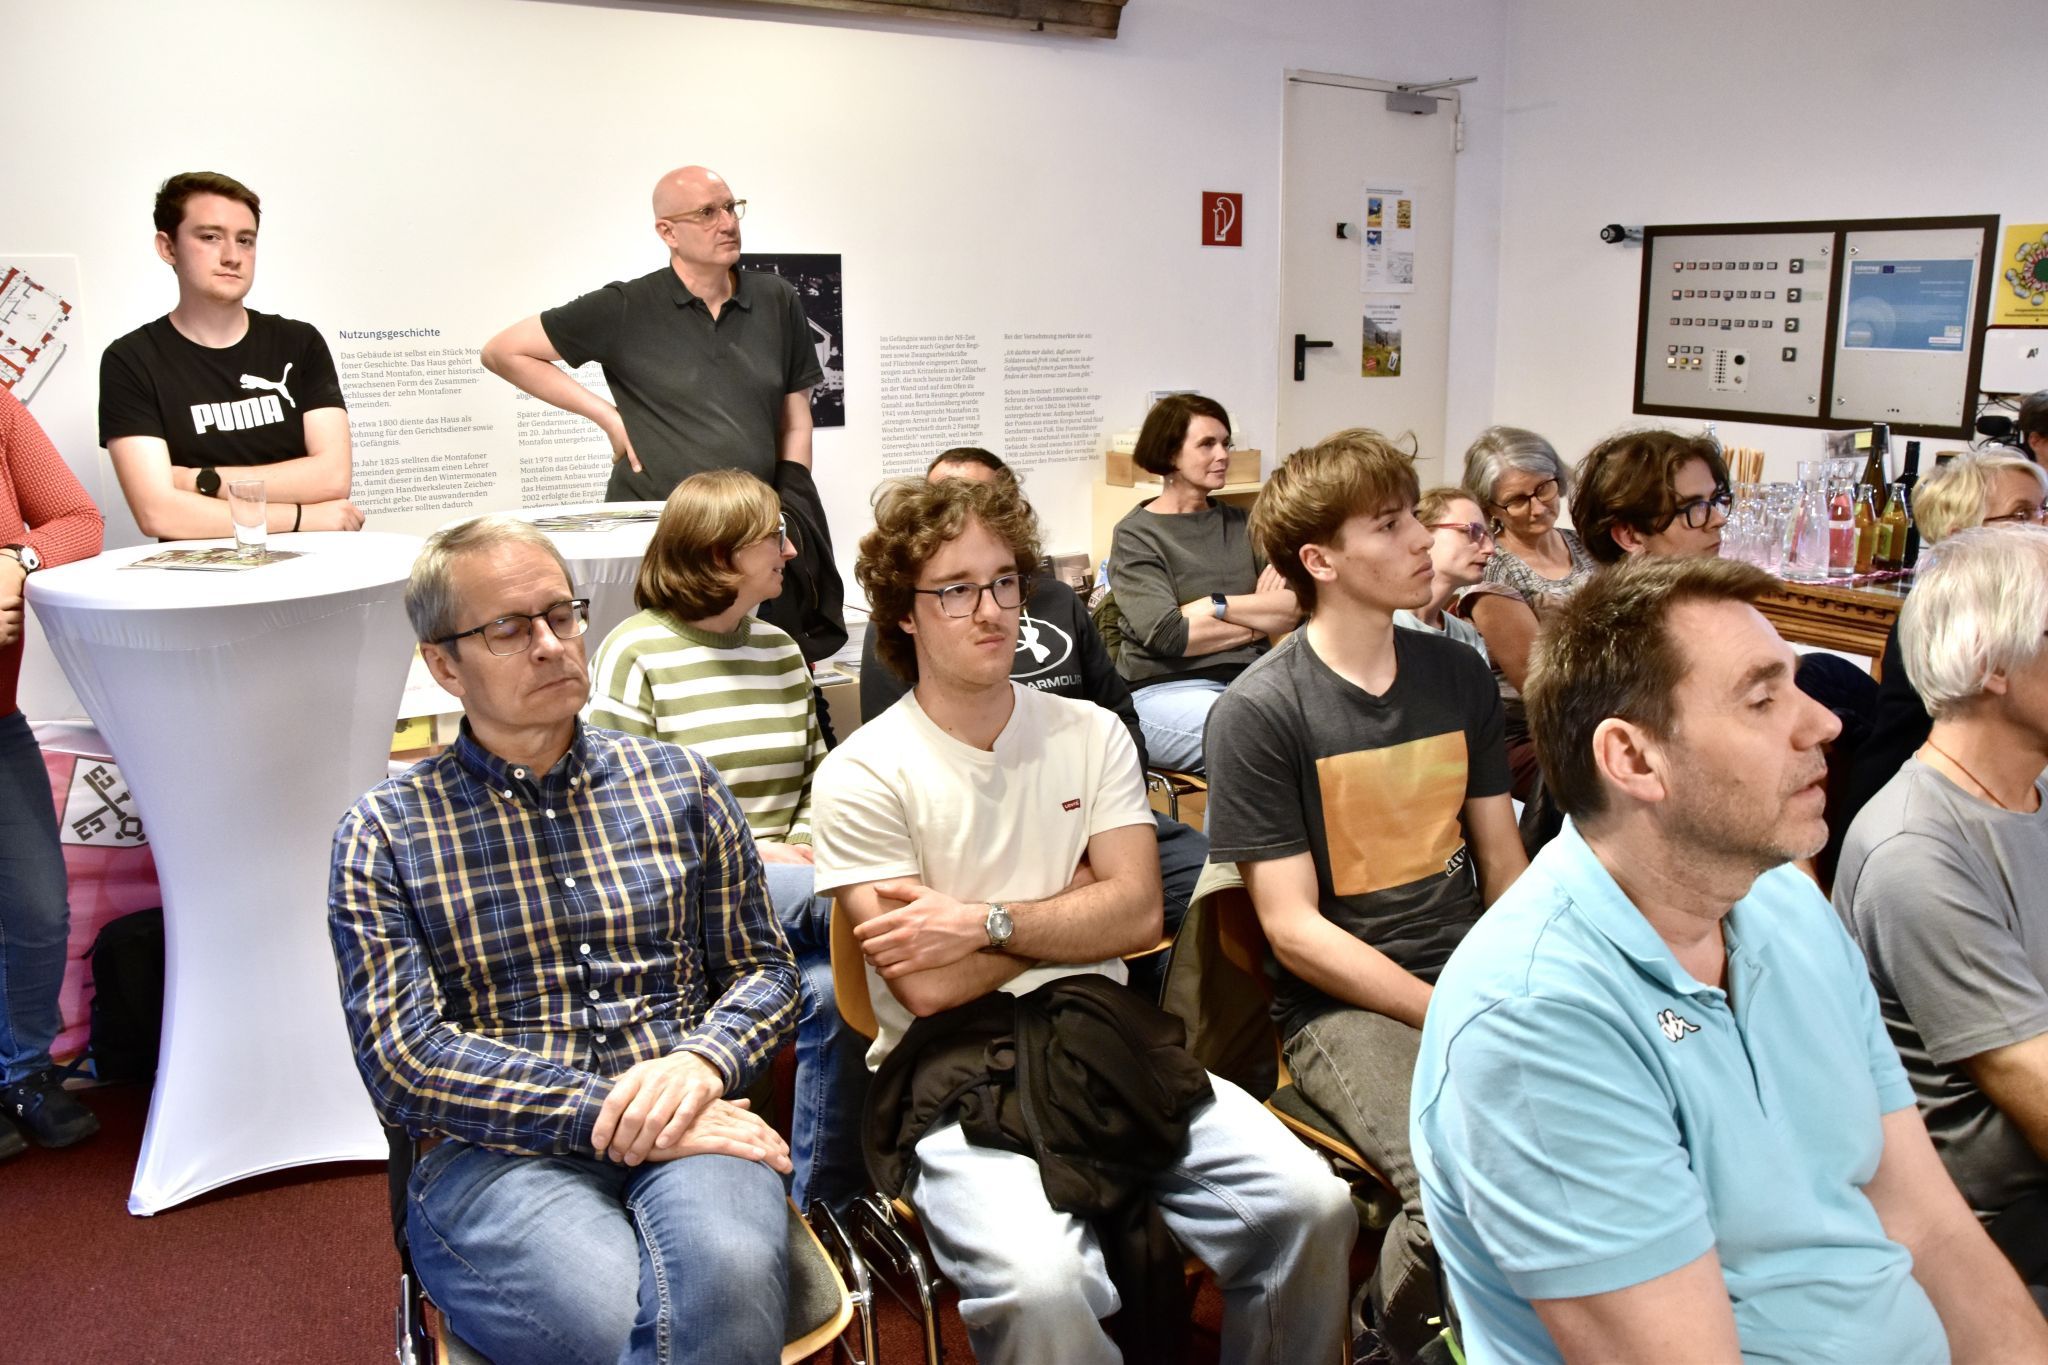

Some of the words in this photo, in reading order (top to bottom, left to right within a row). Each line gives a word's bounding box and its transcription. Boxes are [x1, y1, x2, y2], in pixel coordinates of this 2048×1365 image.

[339, 328, 440, 340] Nutzungsgeschichte
[357, 351, 391, 359] Gebäude
[404, 349, 427, 357] selbst
[442, 348, 463, 356] Stück
[341, 361, 362, 369] foner
[364, 360, 409, 368] Geschichte.
[448, 357, 472, 367] gehört
[361, 370, 384, 378] Stand
[386, 369, 424, 377] Montafon,
[427, 368, 446, 376] einer
[448, 366, 485, 375] historisch
[343, 381, 395, 391] gewachsenen
[397, 379, 417, 387] Form
[420, 378, 432, 386] des
[344, 391, 381, 399] schlusses
[418, 387, 462, 396] Montafoner
[345, 400, 392, 409] Gemeinden.
[190, 394, 284, 434] PUMA
[440, 416, 459, 424] Haus
[461, 415, 472, 423] als
[517, 411, 540, 420] Später
[542, 409, 564, 417] diente
[531, 418, 578, 427] Gendarmerie.
[399, 428, 414, 436] den
[415, 425, 471, 435] Gerichtsdiener
[473, 424, 493, 432] sowie
[542, 427, 585, 435] Jahrhundert
[360, 439, 400, 448] Gefängnis.
[519, 438, 552, 446] Montafon
[554, 434, 604, 445] untergebracht.
[361, 459, 378, 467] Jahr
[380, 457, 399, 466] 1825
[401, 456, 429, 464] stellten
[444, 453, 487, 461] Montafoner
[587, 452, 613, 460] Heimat
[396, 466, 440, 476] gemeinsam
[464, 462, 489, 470] Lehrer
[520, 466, 554, 474] Montafon
[569, 462, 599, 470] Gebäude
[364, 477, 387, 486] damit
[439, 470, 497, 481] Wintermonaten
[521, 475, 538, 483] nach
[351, 489, 365, 497] den
[367, 488, 394, 497] jungen
[396, 483, 462, 494] Handwerksleuten
[464, 481, 496, 489] Zeichen-
[536, 483, 591, 491] Heimatmuseum
[393, 496, 412, 505] gebe.
[415, 494, 427, 502] Die
[429, 490, 487, 501] auswandernden
[522, 493, 539, 501] 2002
[542, 492, 568, 500] erfolgte
[359, 505, 414, 515] uhandwerker
[415, 503, 440, 511] sollten
[442, 500, 473, 509] dadurch
